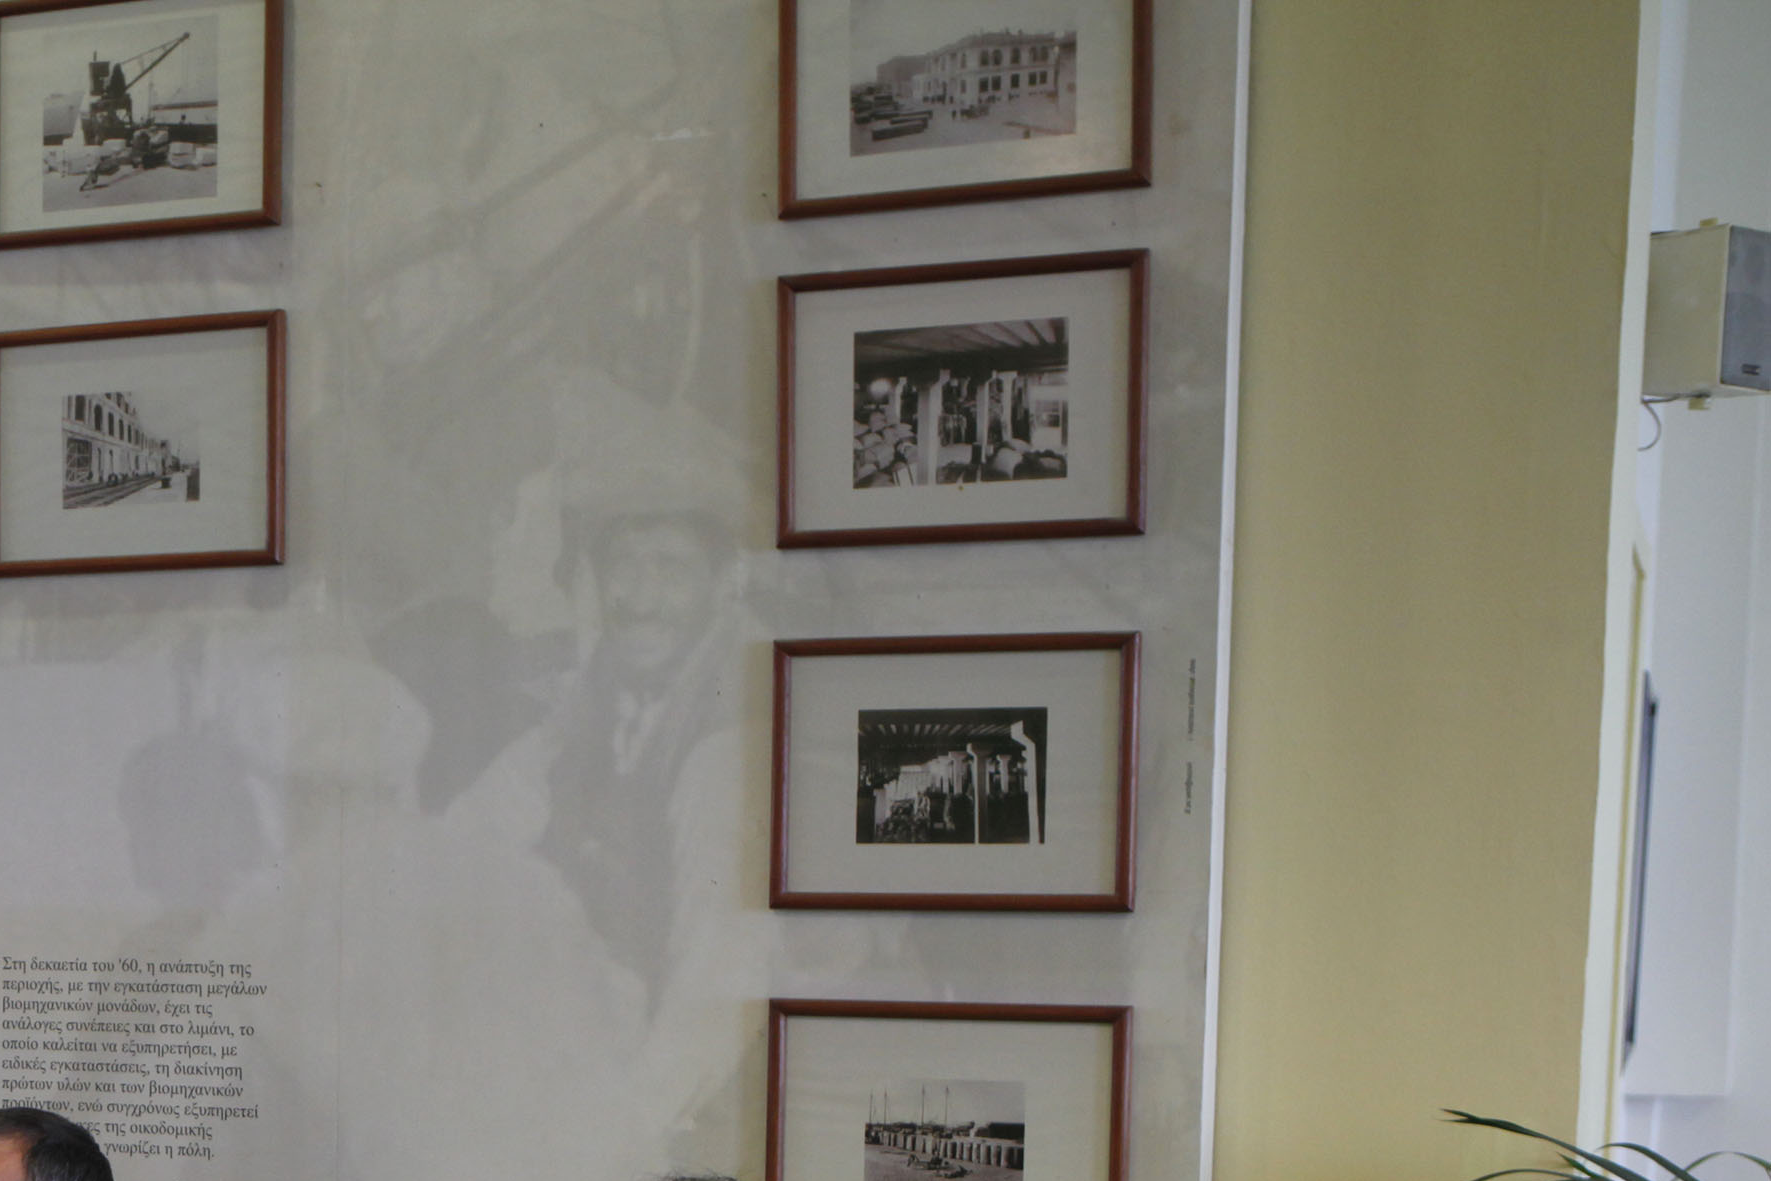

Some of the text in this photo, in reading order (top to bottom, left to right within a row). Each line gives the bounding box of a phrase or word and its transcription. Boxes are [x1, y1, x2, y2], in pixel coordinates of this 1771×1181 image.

[1, 958, 27, 974] Στη
[29, 958, 88, 972] δεκαετία
[91, 963, 115, 973] του
[145, 965, 155, 977] η
[158, 962, 224, 979] ανάπτυξη
[228, 967, 252, 980] της
[1, 979, 267, 999] περιοχής, με την εγκατάσταση μεγάλων
[1, 998, 213, 1018] βιομηχανικών μονάδων, έχει τις
[1, 1018, 255, 1039] ανάλογες συνέπειες και στο λιμάνι, το
[1, 1039, 237, 1060] οποίο καλείται να εξυπηρετήσει, με
[1, 1058, 243, 1081] ειδικές εγκαταστάσεις, τη διακίνηση
[1, 1078, 244, 1100] πρώτων υλών και των βιομηχανικών
[77, 1100, 258, 1121] ενώ συγχρόνως εξυπηρετεί
[104, 1142, 214, 1162] γνωρίζει η πόλη.
